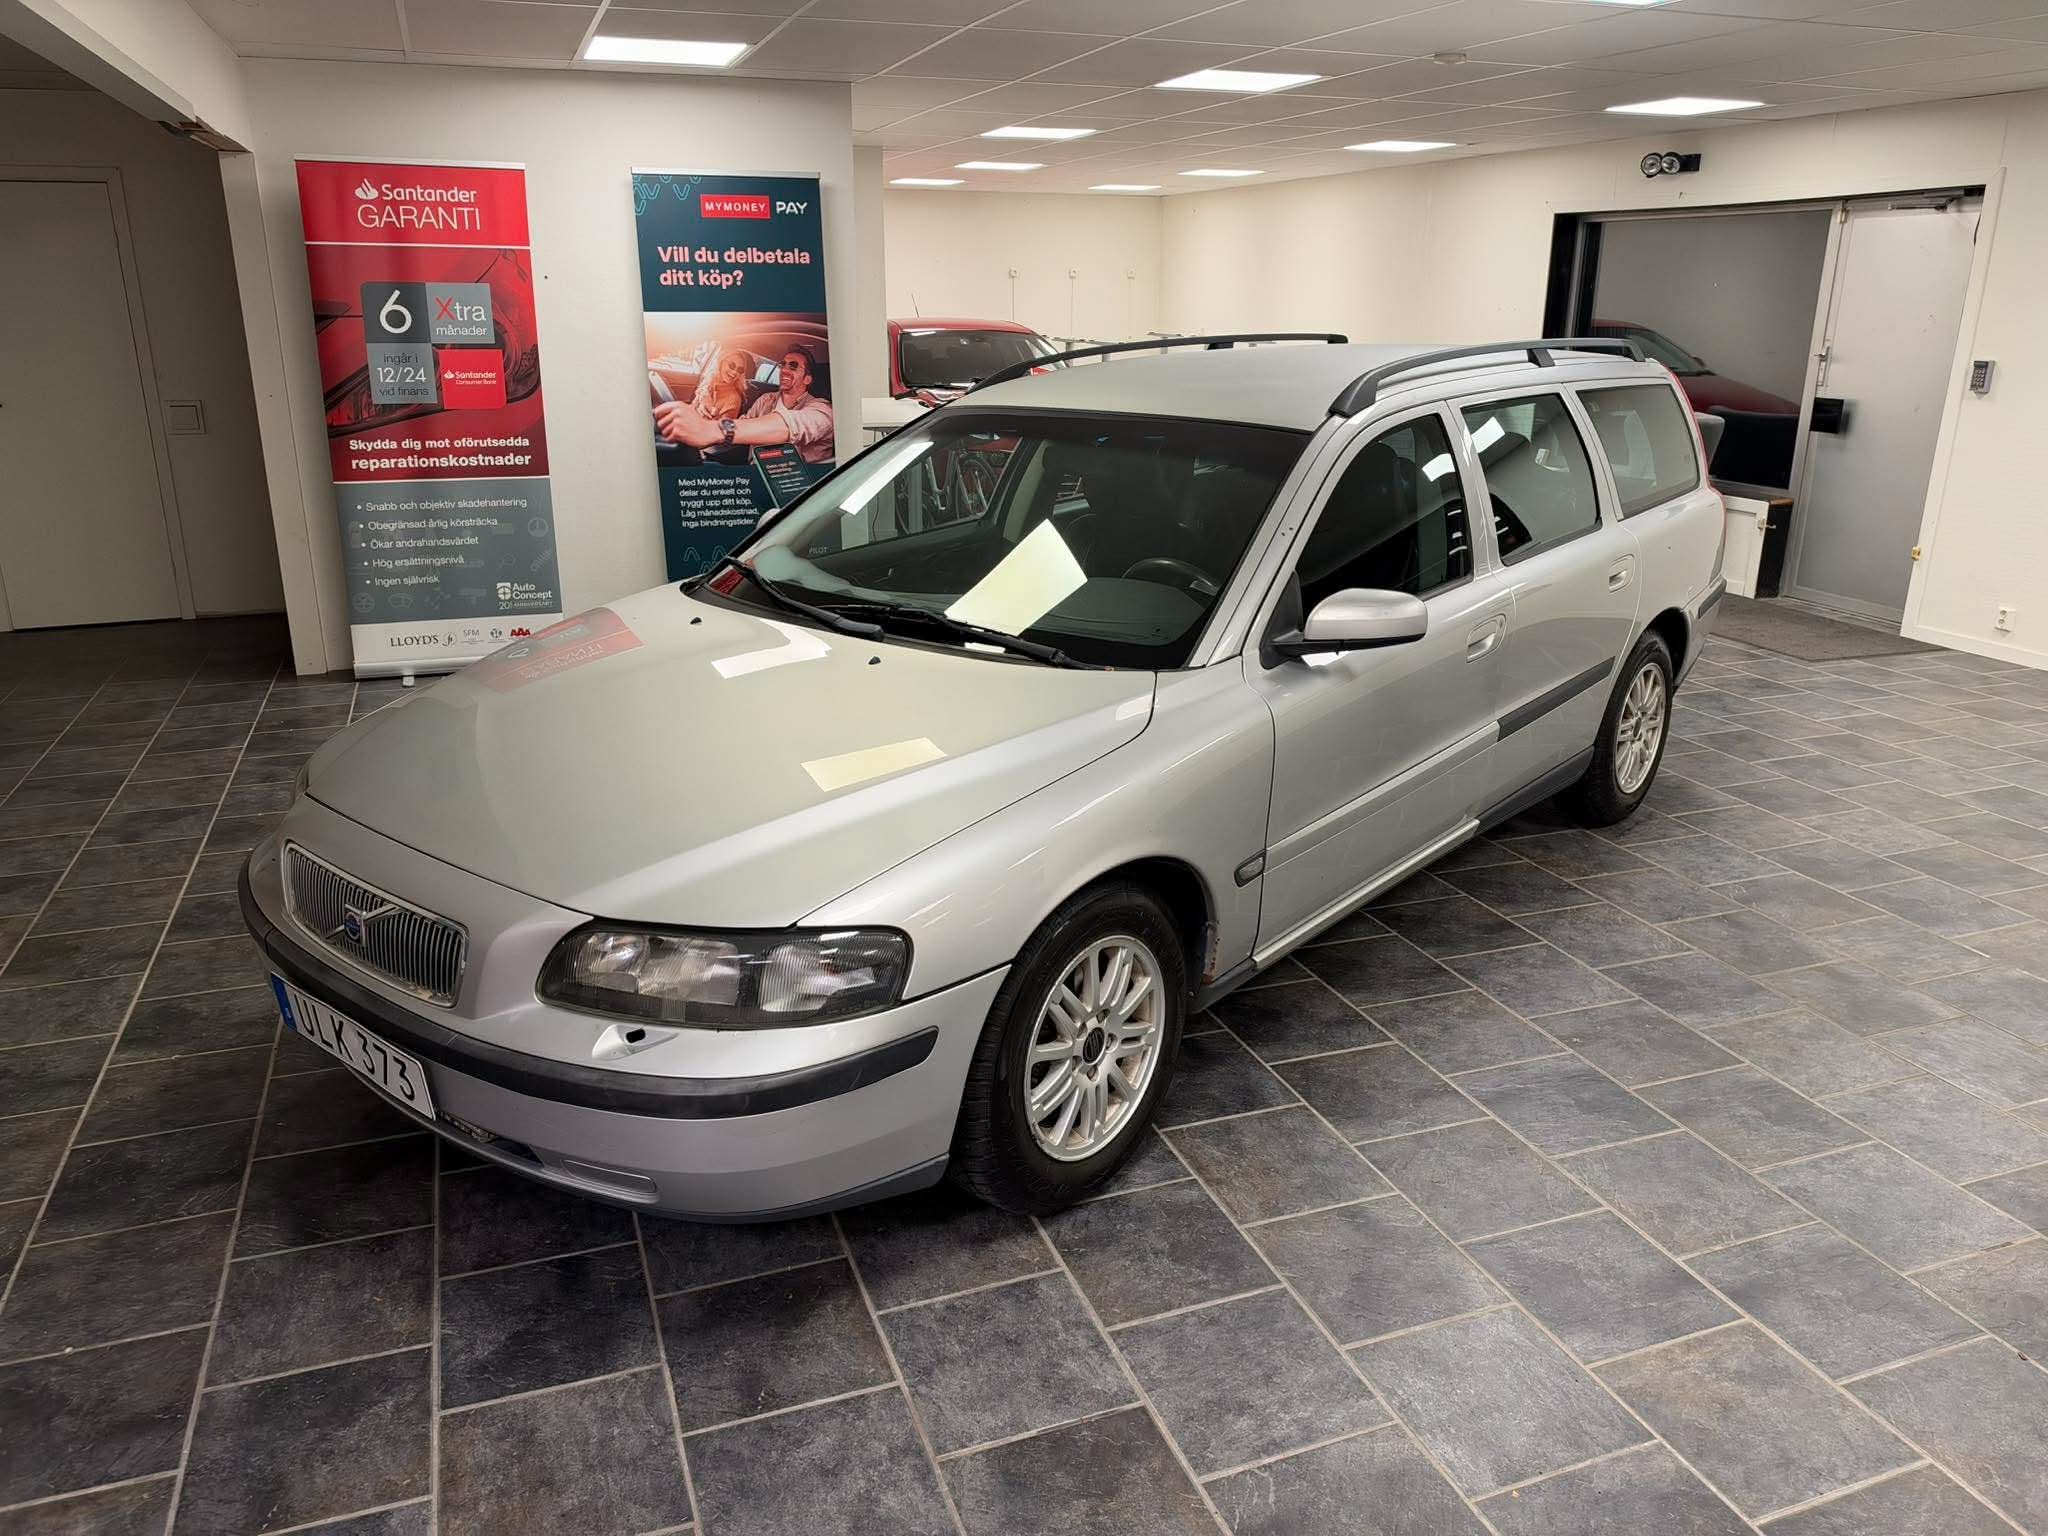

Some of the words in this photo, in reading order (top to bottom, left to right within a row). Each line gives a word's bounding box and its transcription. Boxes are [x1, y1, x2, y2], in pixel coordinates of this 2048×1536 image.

[382, 184, 477, 202] Santander
[705, 201, 766, 212] MYMONEY
[776, 201, 807, 214] PAY
[358, 204, 481, 230] GARANTI
[657, 246, 689, 263] Vill
[694, 247, 719, 263] du
[723, 247, 810, 264] delbetala
[659, 270, 694, 285] ditt
[698, 269, 743, 289] köp?
[380, 289, 412, 334] 6
[434, 296, 486, 321] Xtra
[436, 324, 487, 337] månader
[384, 352, 412, 365] ingår
[376, 367, 426, 383] 12/24
[455, 370, 496, 379] Santander
[379, 387, 395, 396] vid
[398, 386, 429, 396] finans
[349, 439, 398, 452] Skydda
[401, 438, 422, 450] dig
[425, 438, 451, 449] mot
[454, 436, 529, 448] oförutsedda
[351, 453, 531, 472] reparationskostnader
[678, 478, 696, 486] Med
[697, 478, 734, 487] MyMoney
[735, 477, 750, 485] Pay
[365, 501, 397, 512] Snabb
[400, 500, 417, 510] och
[419, 499, 456, 511] objektiv
[457, 498, 528, 508] skadehantering
[680, 500, 704, 508] tryggt
[722, 498, 735, 506] ditt
[681, 509, 696, 518] Låg
[368, 520, 426, 531] Obegränsad
[428, 518, 448, 530] årlig
[450, 517, 498, 527] körsträcka
[370, 538, 393, 549] Ökar
[395, 536, 479, 548] andrahandsvärdet
[372, 558, 393, 569] Hög
[394, 554, 465, 567] ersättningsnivå
[374, 577, 401, 588] Ingen
[403, 575, 440, 586] självrisk
[512, 582, 536, 591] Auto
[512, 590, 552, 600] Concept
[390, 634, 439, 647] LLOYD'S
[294, 993, 353, 1063] ULK
[357, 1030, 416, 1101] 373
